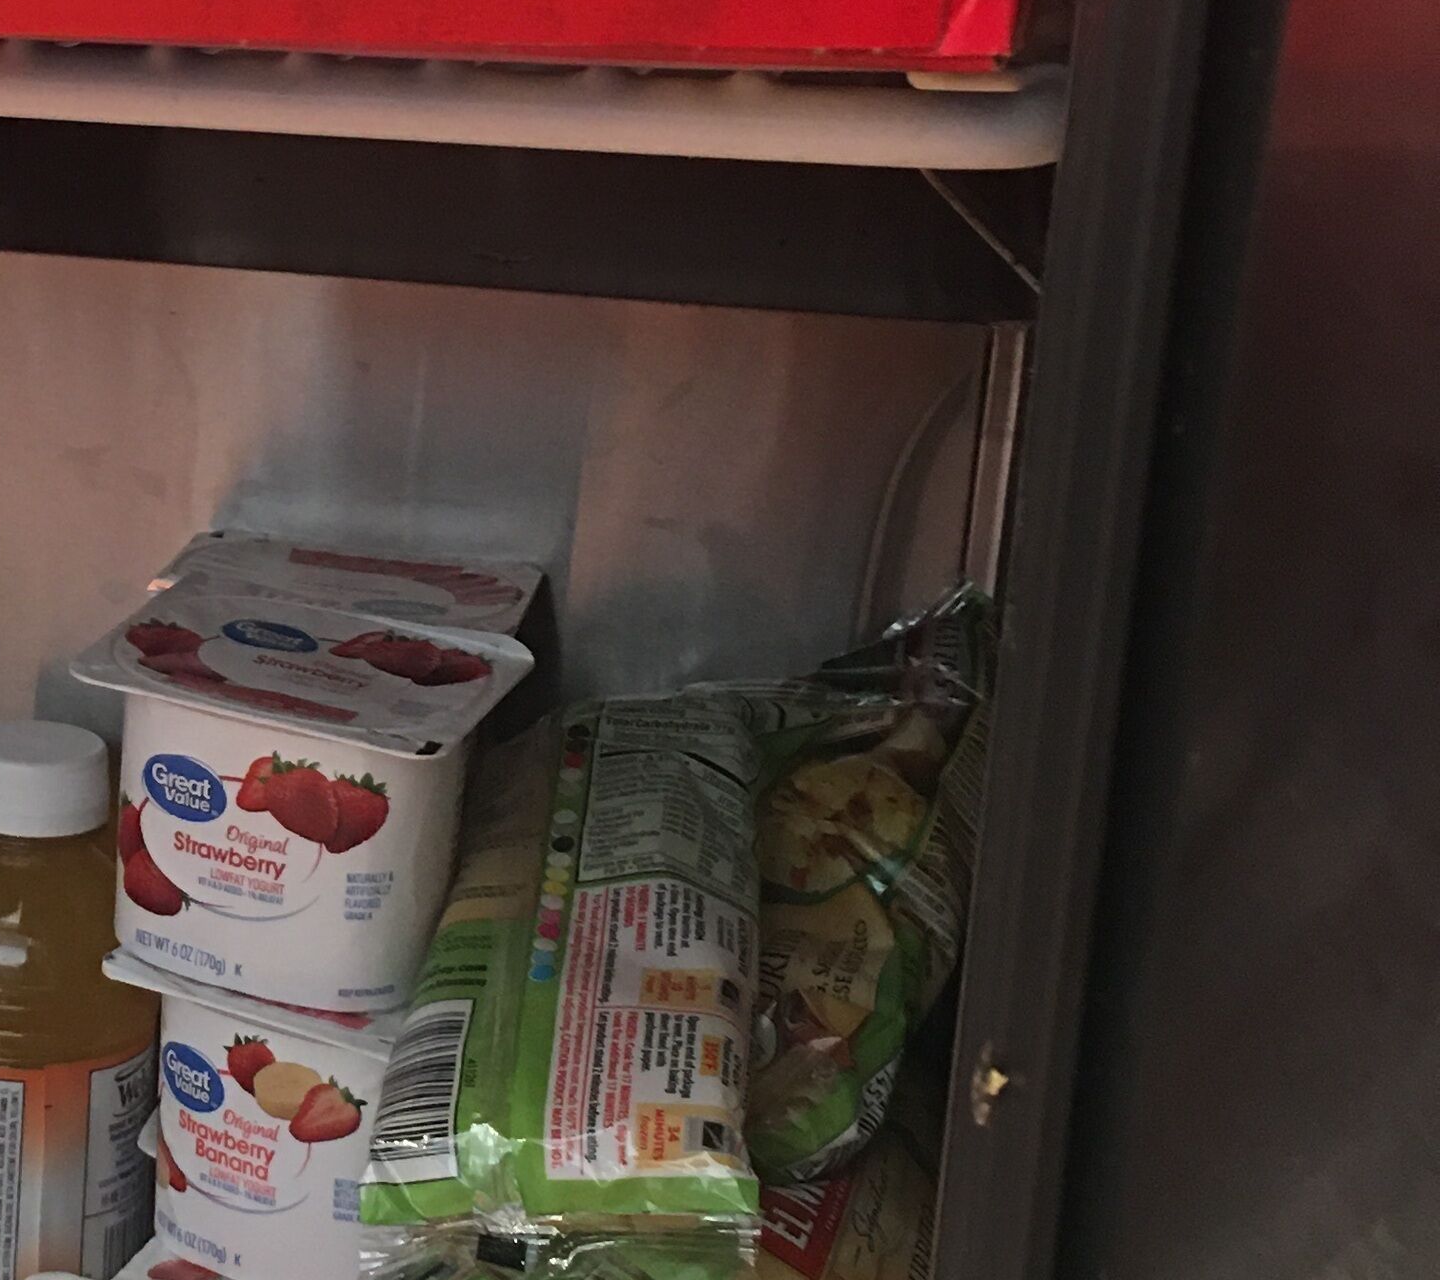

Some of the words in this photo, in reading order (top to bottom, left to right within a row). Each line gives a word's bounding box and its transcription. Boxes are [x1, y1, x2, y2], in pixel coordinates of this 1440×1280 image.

[151, 763, 211, 799] Great
[164, 786, 210, 812] Value
[174, 831, 286, 880] Strawberry
[227, 825, 289, 855] Original
[210, 868, 244, 885] LOWFAT
[247, 876, 285, 895] YOGURT
[135, 928, 150, 945] NET
[155, 933, 170, 953] WT
[171, 939, 178, 956] 6
[180, 944, 193, 962] OZ
[195, 950, 226, 976] (170g)
[166, 1050, 211, 1090] Great
[175, 1073, 210, 1103] Value
[553, 1071, 567, 1107] PRODUCT
[223, 1109, 280, 1142] Original
[553, 1108, 563, 1128] MAY
[588, 1102, 601, 1127] before
[179, 1109, 275, 1165] Strawberry
[653, 1108, 664, 1160] MINUTES
[668, 1125, 680, 1143] 34
[195, 1139, 269, 1181] Banana
[762, 1208, 814, 1250] EL
[184, 1231, 196, 1249] OZ
[197, 1238, 227, 1264] (170g)
